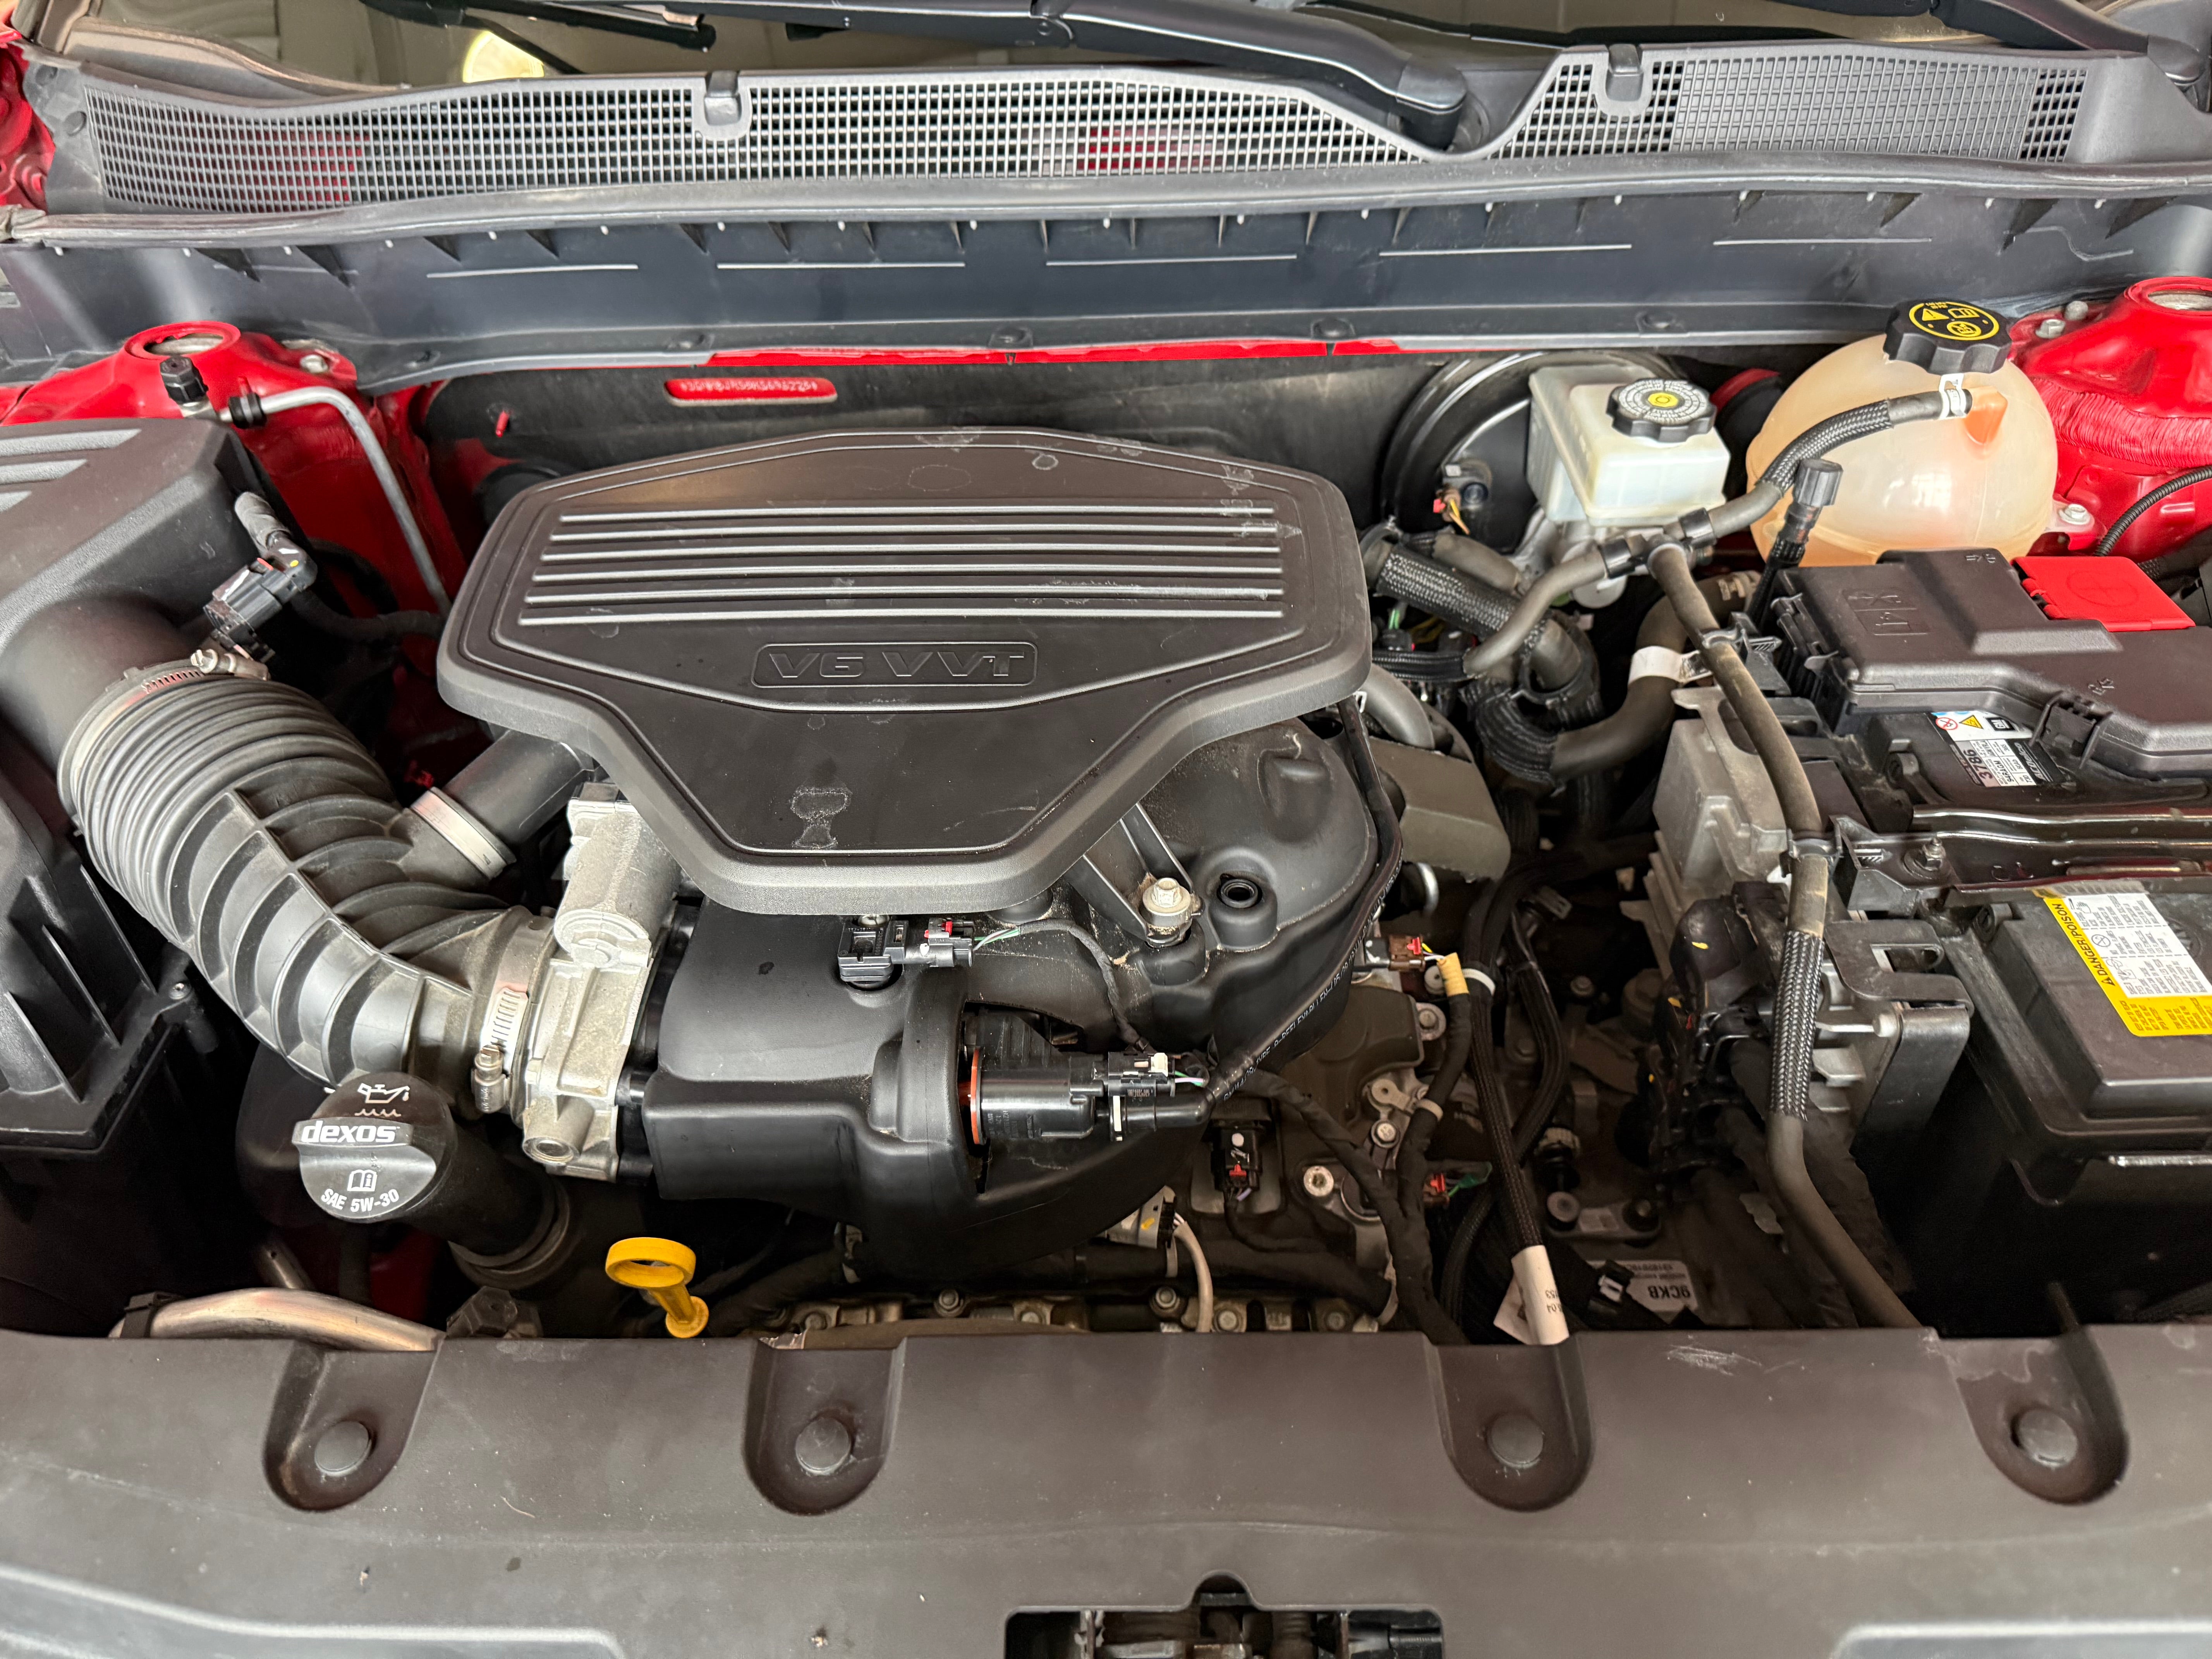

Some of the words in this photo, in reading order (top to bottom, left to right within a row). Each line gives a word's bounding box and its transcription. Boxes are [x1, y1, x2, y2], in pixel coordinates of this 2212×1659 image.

[769, 651, 864, 678] V6
[882, 651, 1025, 677] VVT
[1990, 719, 2005, 729] GM
[1963, 749, 1993, 780] 3786
[2014, 742, 2047, 781] ACDelco
[2052, 903, 2108, 976] DANGER/POISON
[301, 1120, 397, 1143] dexos
[321, 1188, 347, 1210] SAE
[350, 1188, 400, 1212] 5W-30
[1647, 1285, 1691, 1301] 9CKB
